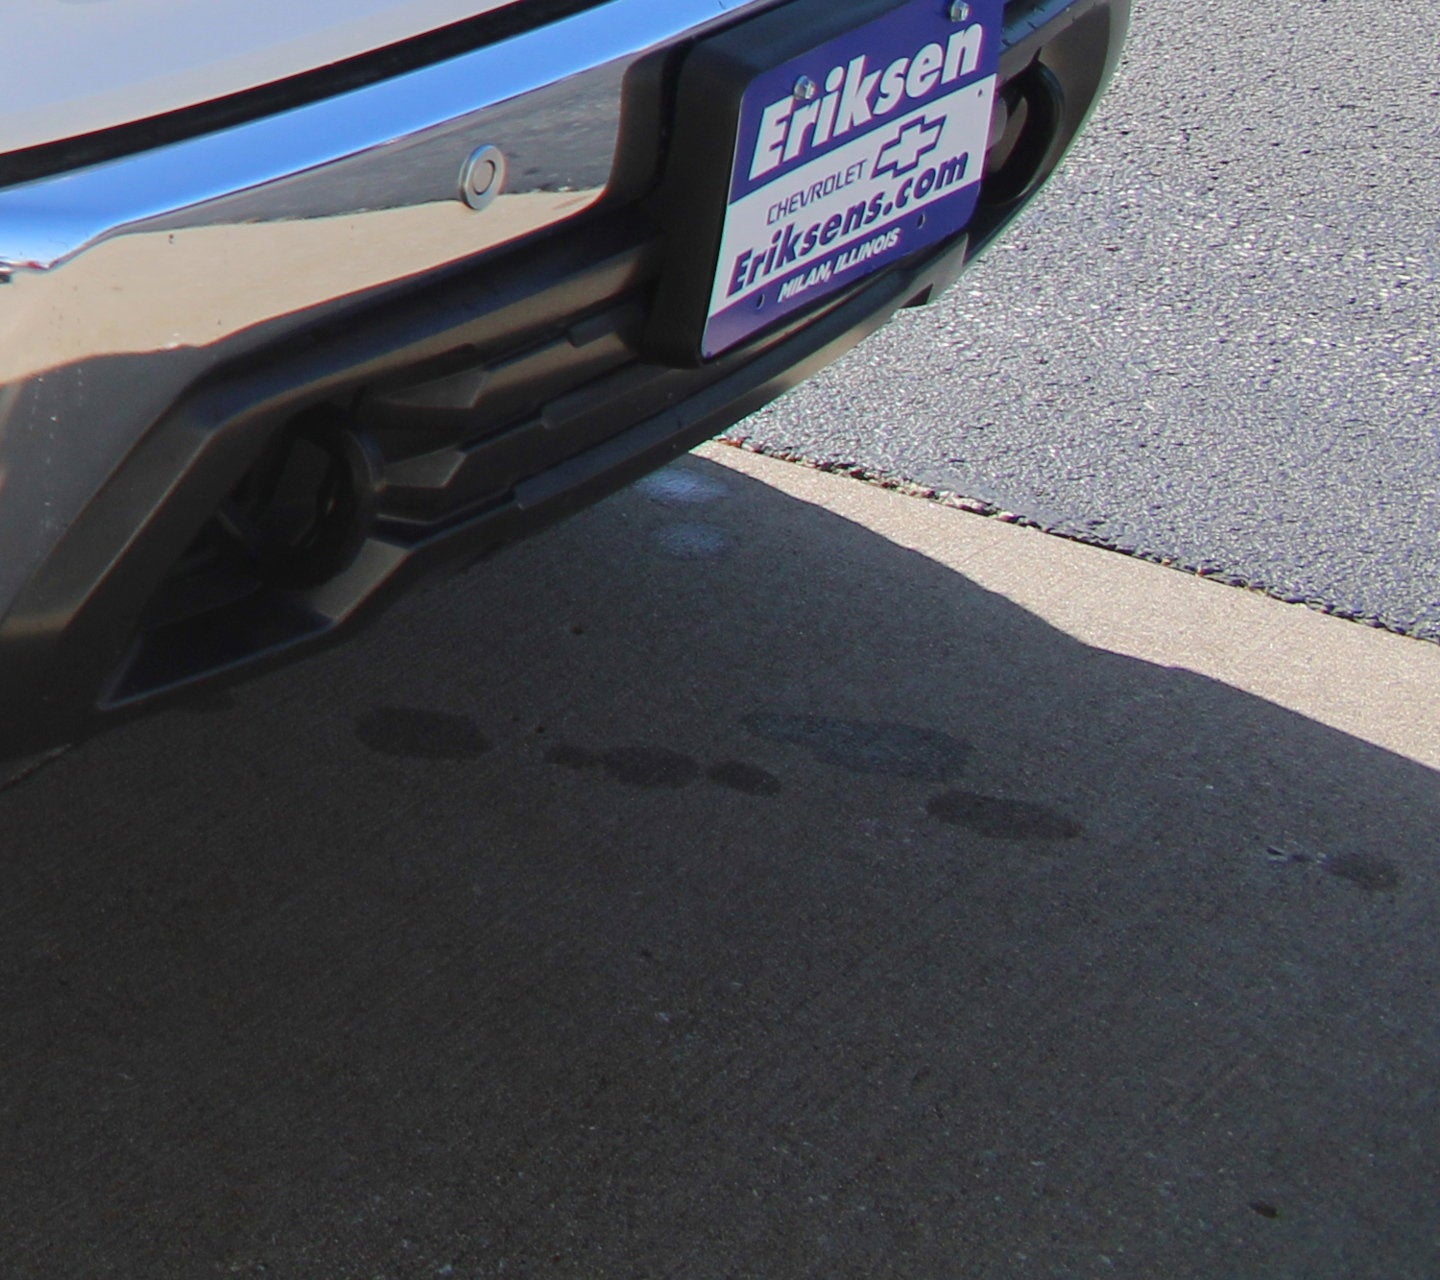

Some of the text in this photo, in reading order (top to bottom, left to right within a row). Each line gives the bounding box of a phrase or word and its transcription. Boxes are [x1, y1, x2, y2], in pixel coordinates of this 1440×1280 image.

[748, 21, 984, 181] Eriksen
[725, 148, 969, 298] Eriksens.com
[766, 158, 868, 226] CHEVROLET
[777, 227, 901, 303] MILAN, ILLINOIS
